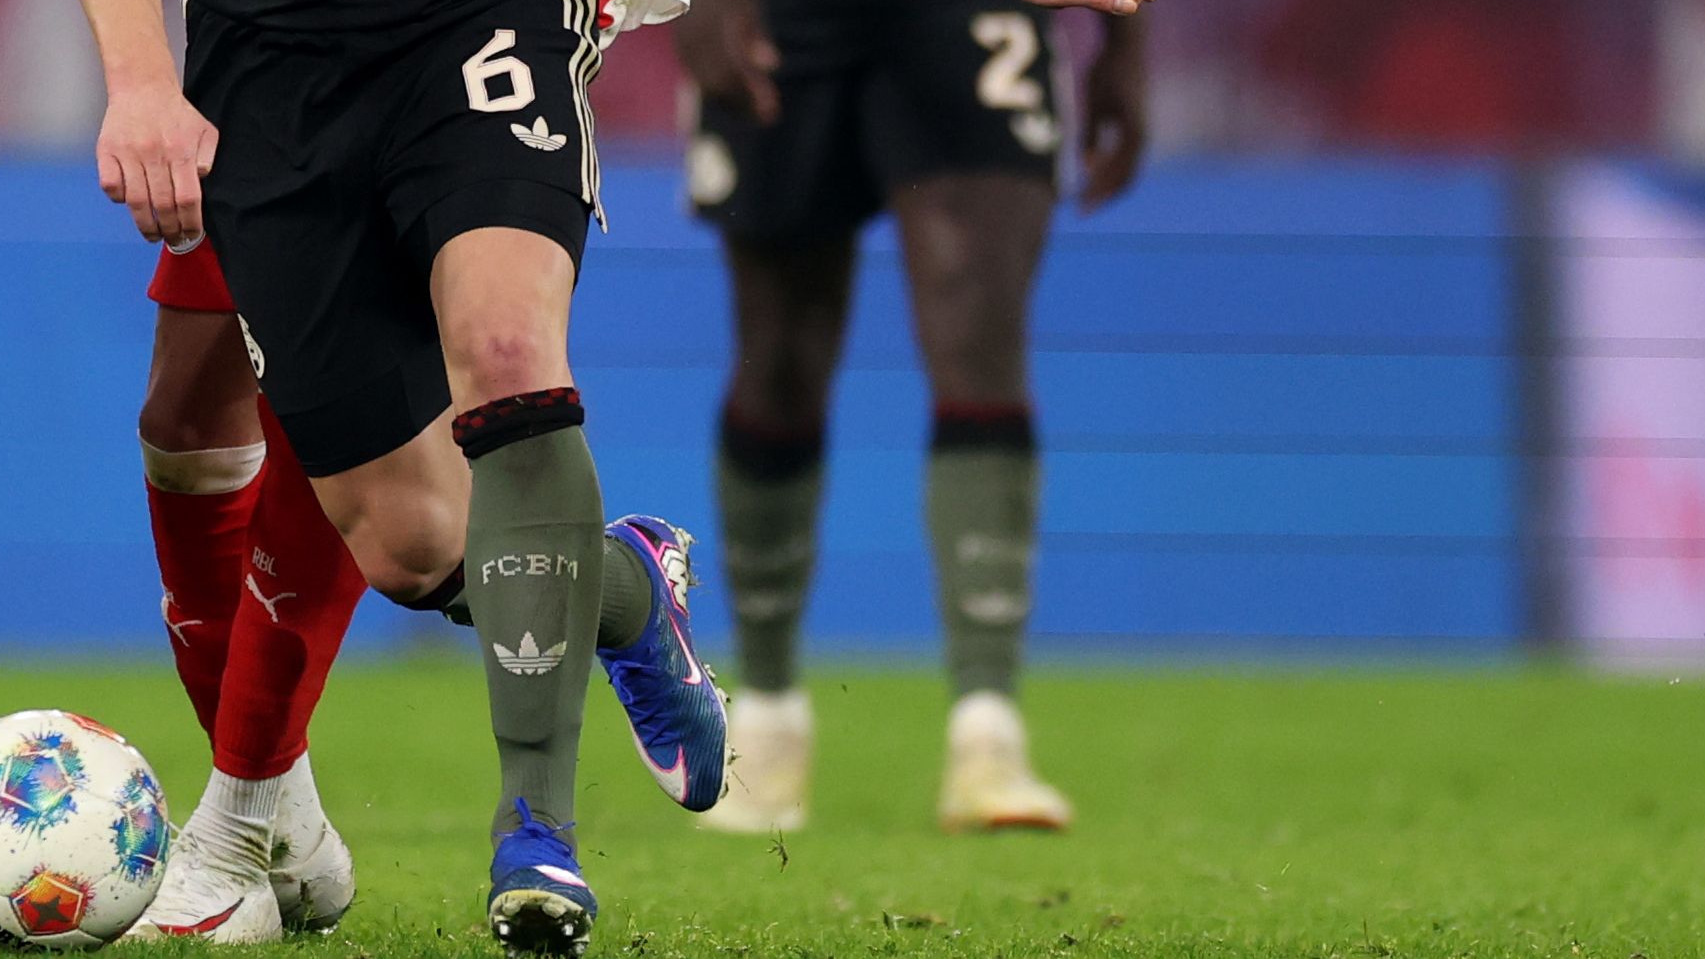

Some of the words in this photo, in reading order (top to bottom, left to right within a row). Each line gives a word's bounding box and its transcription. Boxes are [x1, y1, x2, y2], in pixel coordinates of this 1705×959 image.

[462, 29, 535, 112] 6
[252, 545, 277, 577] RBL
[482, 554, 578, 585] FCBM
